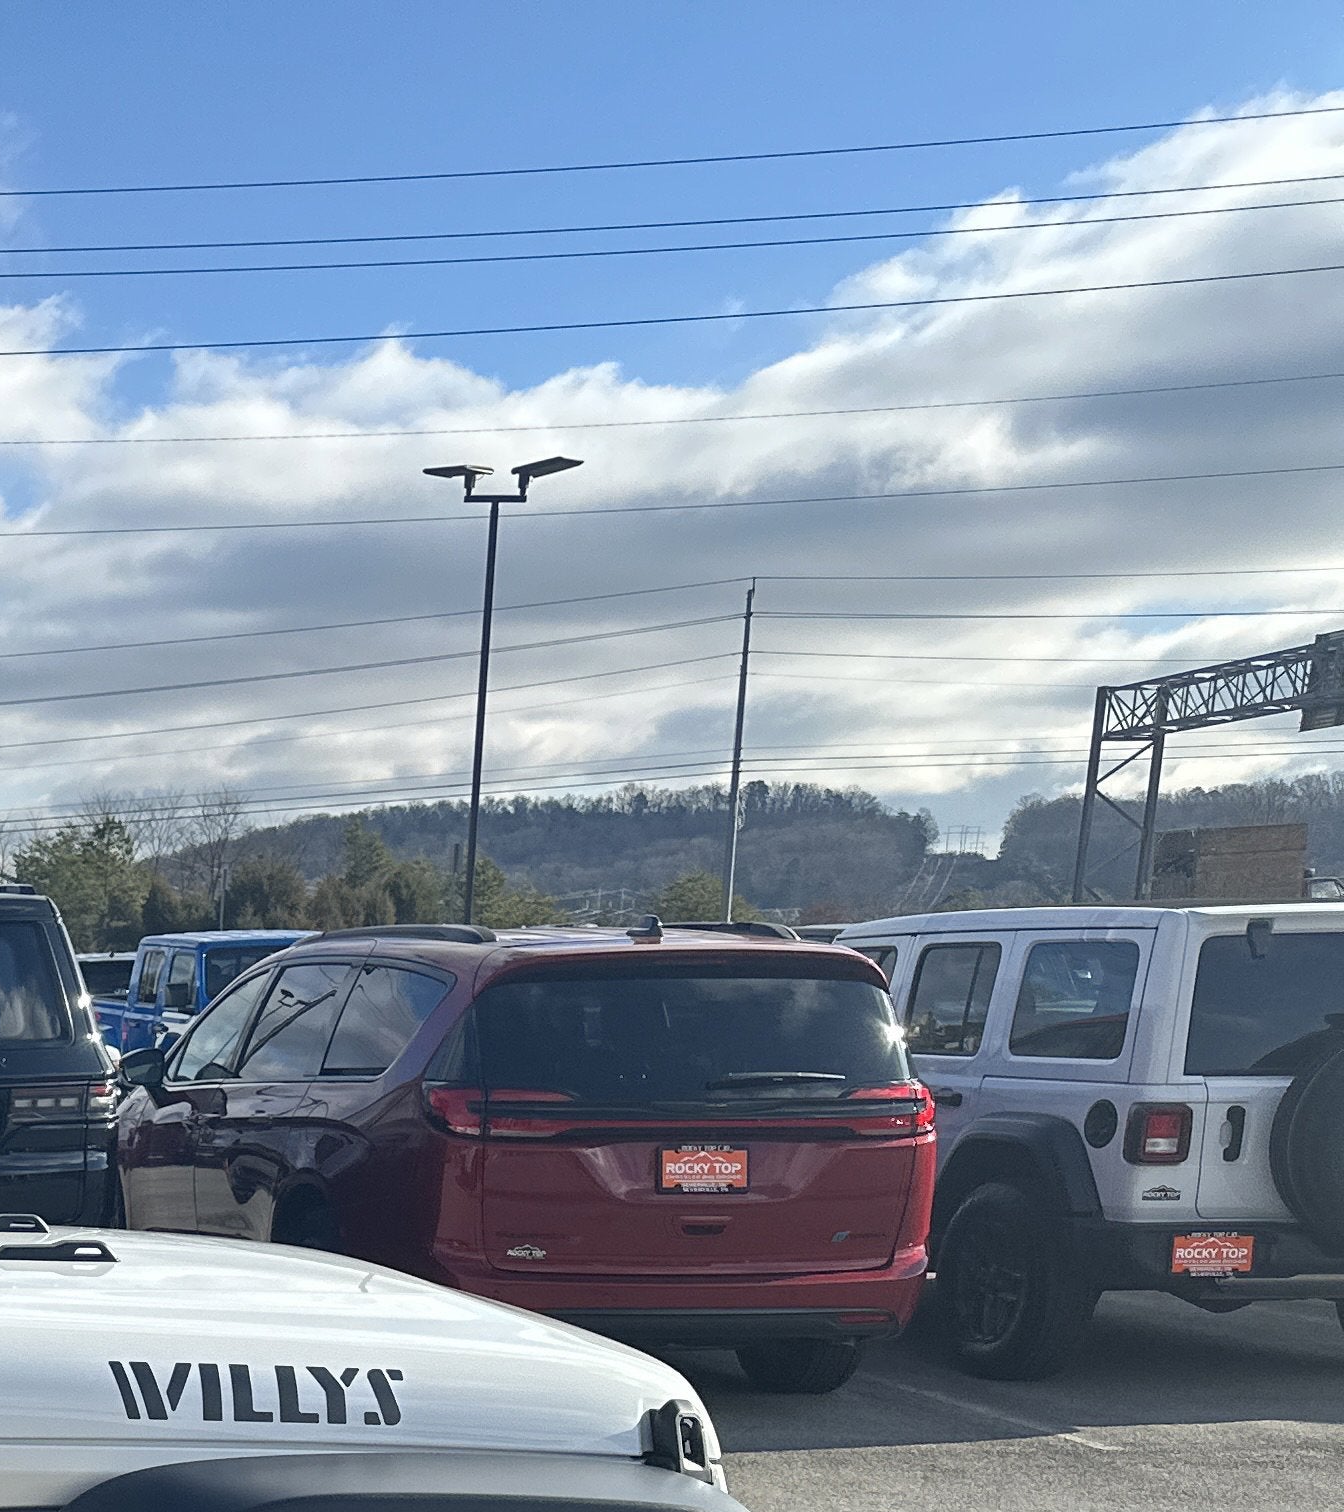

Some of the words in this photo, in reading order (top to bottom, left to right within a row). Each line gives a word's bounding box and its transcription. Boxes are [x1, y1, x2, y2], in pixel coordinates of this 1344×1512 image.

[666, 1163, 710, 1174] ROCKY
[713, 1163, 742, 1174] TOP
[1176, 1248, 1219, 1259] ROCKY
[1221, 1248, 1248, 1259] TOP
[108, 1360, 404, 1426] WILLYS
